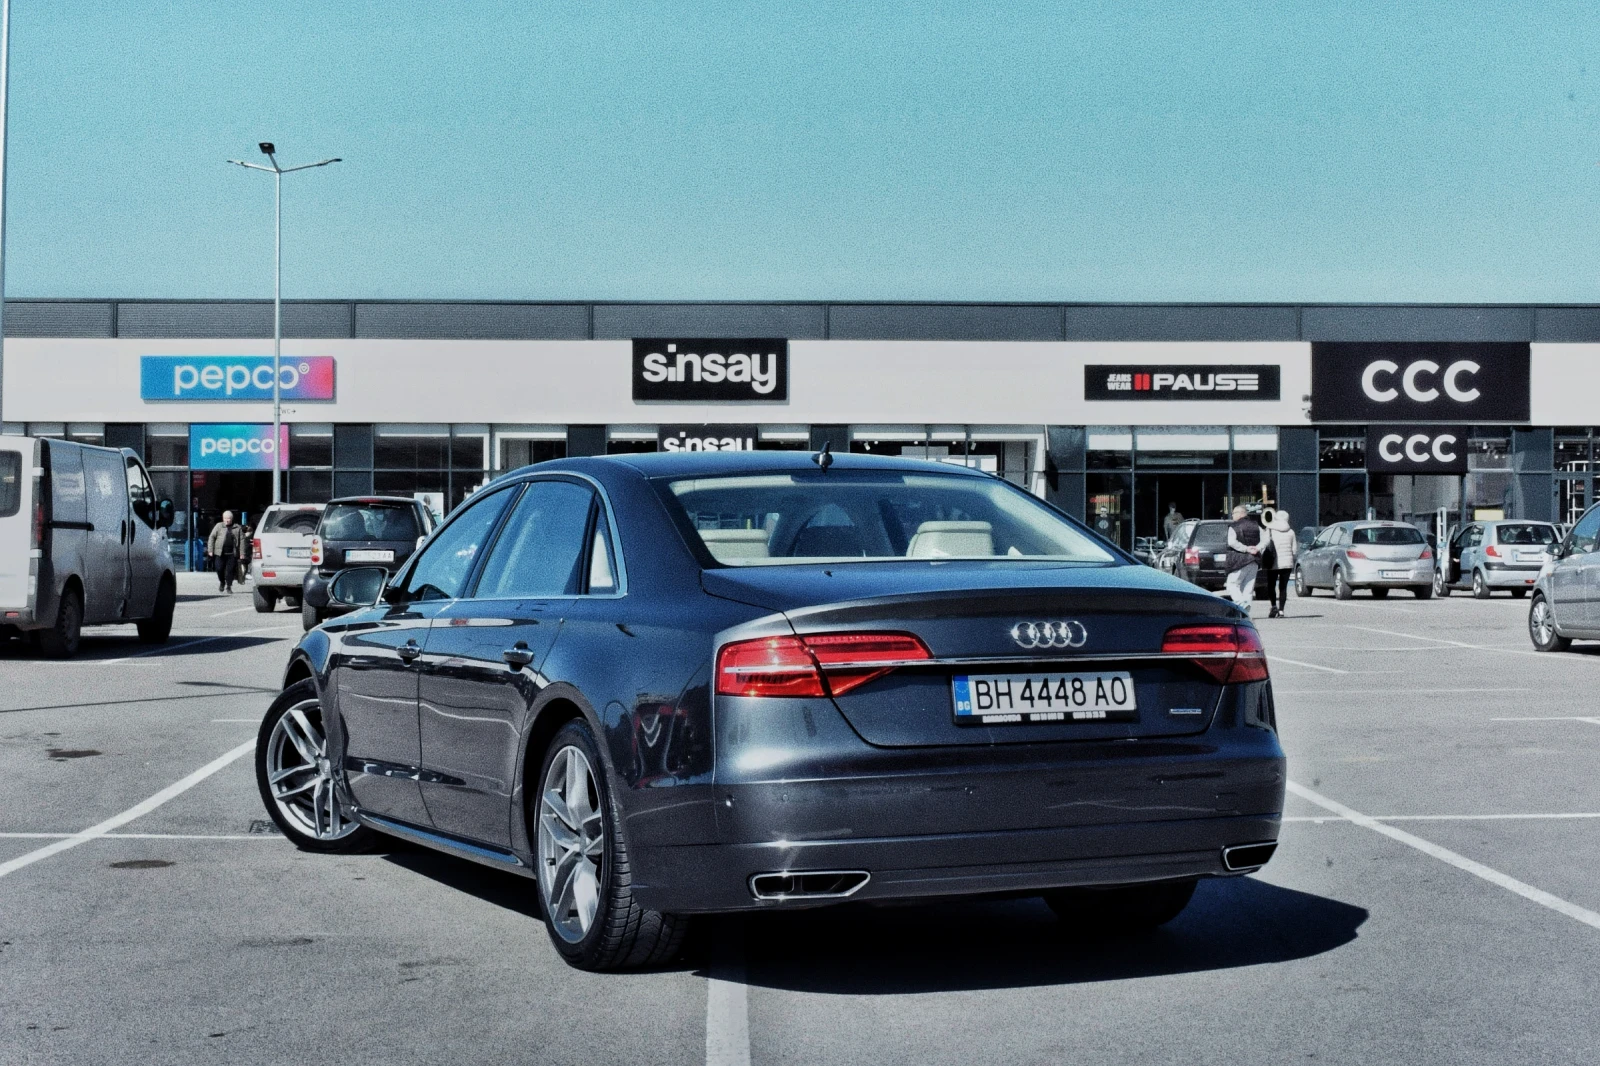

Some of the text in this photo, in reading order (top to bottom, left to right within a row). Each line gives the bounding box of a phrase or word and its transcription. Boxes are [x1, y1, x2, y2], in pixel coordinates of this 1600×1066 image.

[174, 365, 299, 395] pepco
[643, 344, 777, 394] sinsay
[1107, 374, 1132, 382] JEANS
[1362, 360, 1481, 402] CCC
[1107, 382, 1132, 391] WEAR
[1153, 373, 1259, 391] PAUSE
[201, 438, 275, 457] pepco
[1378, 434, 1457, 463] CCC
[975, 679, 1013, 710] BH
[1020, 677, 1087, 708] 4448
[956, 701, 971, 711] BG
